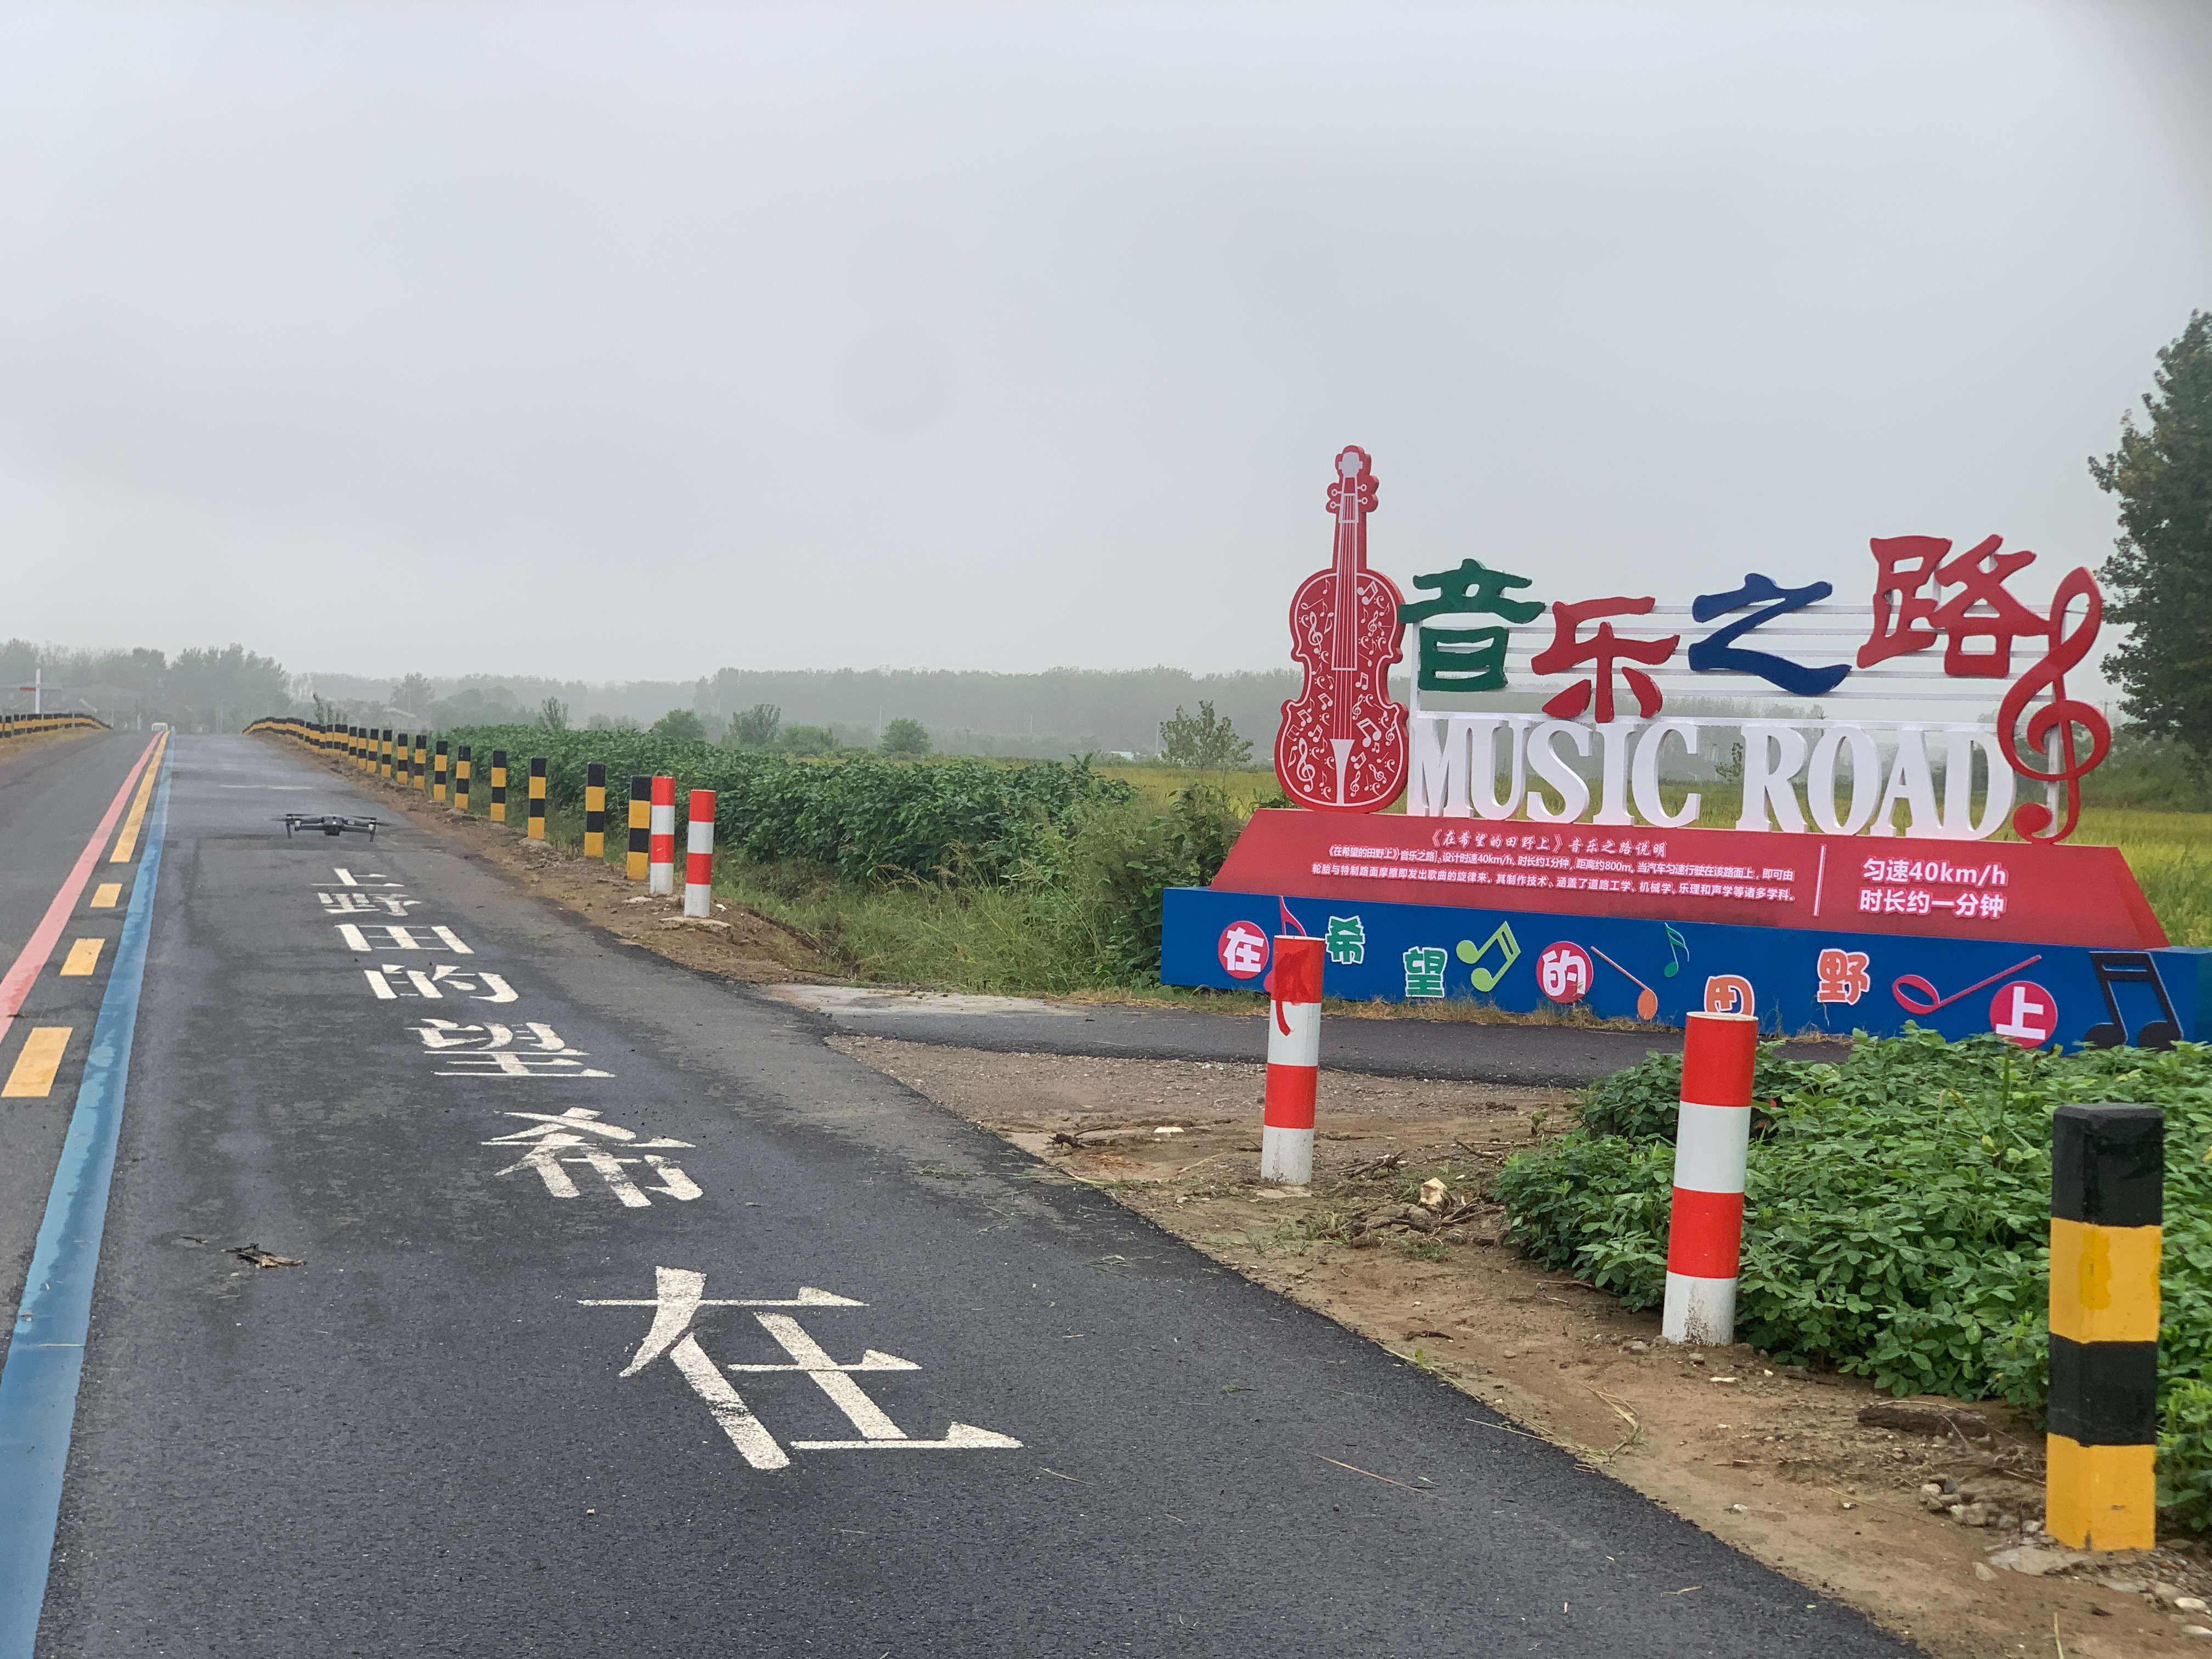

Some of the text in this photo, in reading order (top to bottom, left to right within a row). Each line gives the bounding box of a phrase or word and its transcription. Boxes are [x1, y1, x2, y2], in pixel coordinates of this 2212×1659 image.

[1398, 534, 2053, 723] 音乐之路
[1408, 720, 2017, 840] MUSIC ROAD
[1432, 828, 1667, 857] 《在希望的田野上》音乐之路说明
[1863, 858, 2006, 887] 匀速40km/h
[1859, 889, 2005, 918] 时长约一分钟
